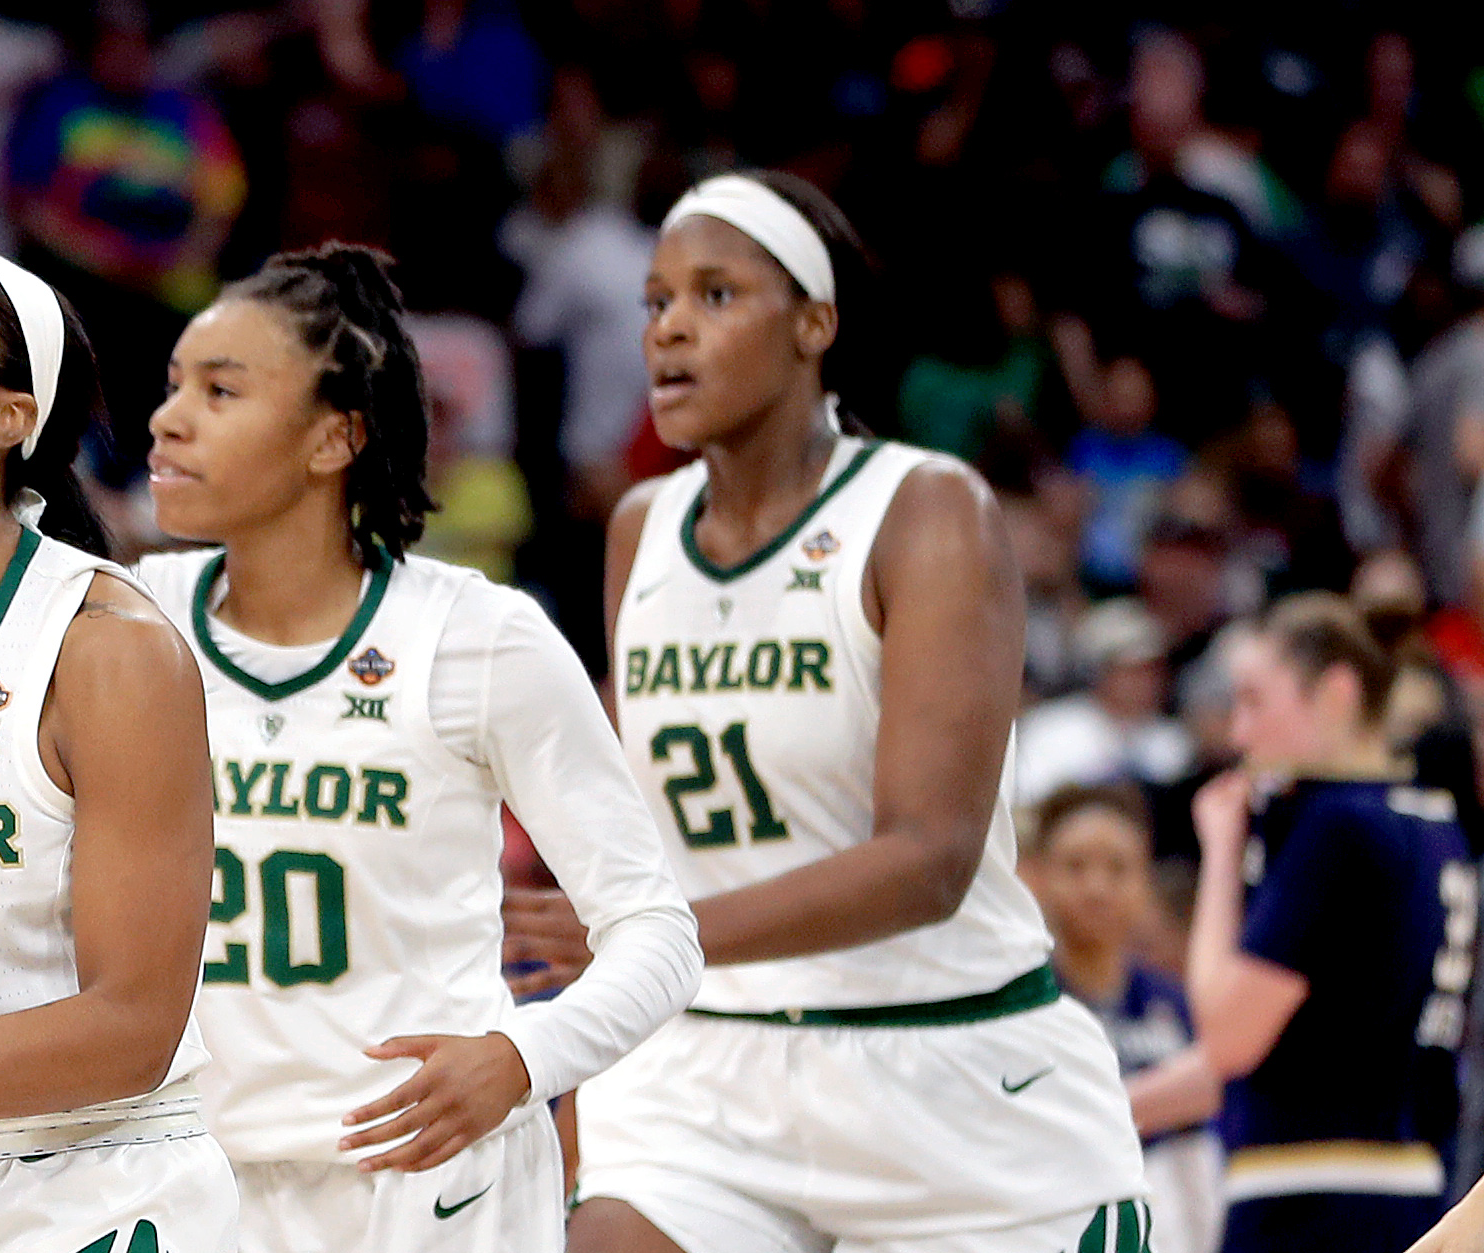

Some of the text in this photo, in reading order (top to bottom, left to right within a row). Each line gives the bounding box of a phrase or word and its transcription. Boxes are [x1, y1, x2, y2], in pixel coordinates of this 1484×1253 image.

[625, 639, 833, 697] BAYLOR
[342, 691, 392, 722] XII
[213, 760, 409, 828] YLOR
[650, 721, 790, 850] 21
[201, 847, 351, 988] 20
